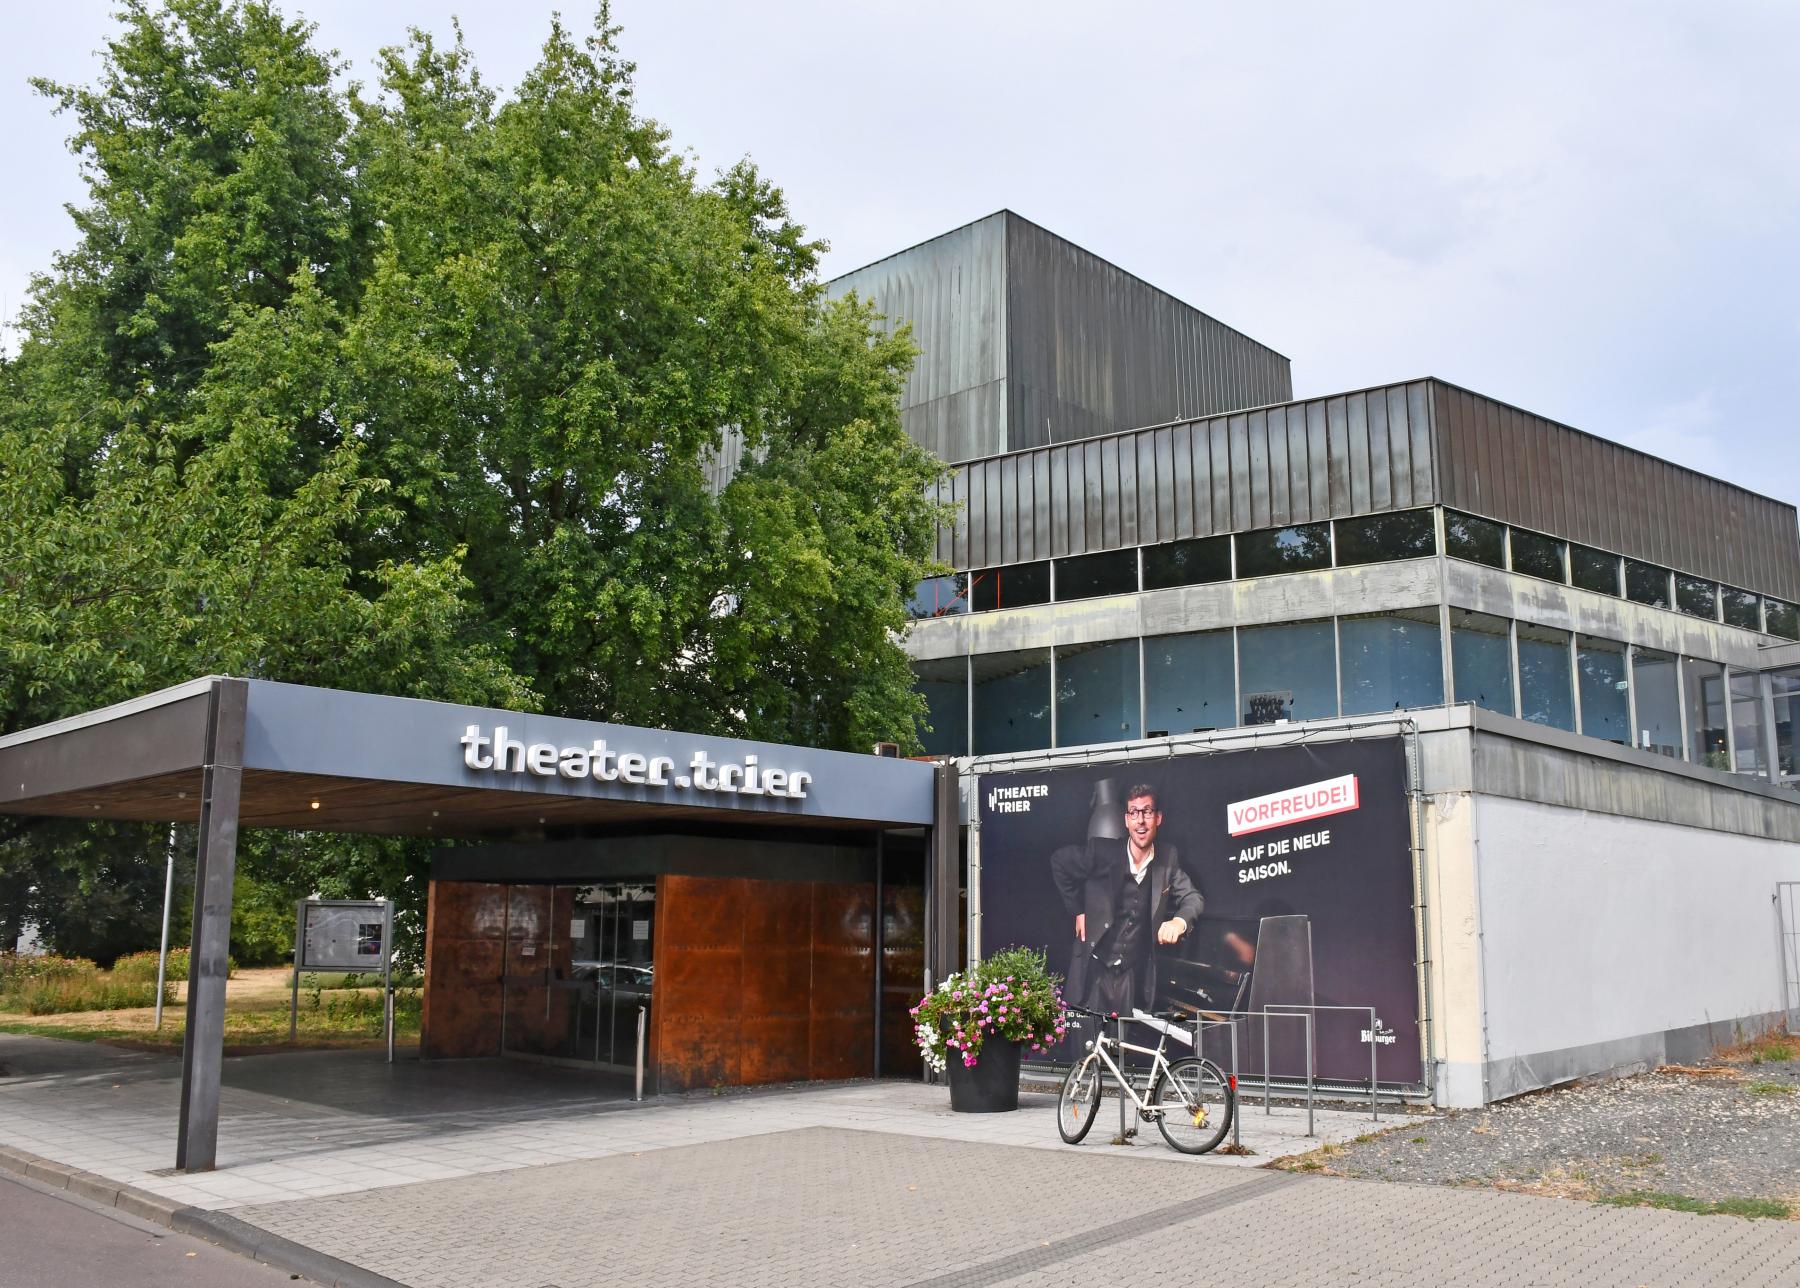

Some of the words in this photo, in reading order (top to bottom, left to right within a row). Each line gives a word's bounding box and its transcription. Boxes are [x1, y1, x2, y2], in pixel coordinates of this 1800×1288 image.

[460, 725, 812, 799] theater.trier
[997, 785, 1049, 799] THEATER
[1234, 785, 1347, 825] VORFREUDE!
[997, 800, 1031, 813] TRIER
[1239, 845, 1265, 863] AUF
[1268, 840, 1290, 857] DIE
[1293, 830, 1331, 851] NEUE
[1238, 860, 1292, 883] SAISON.
